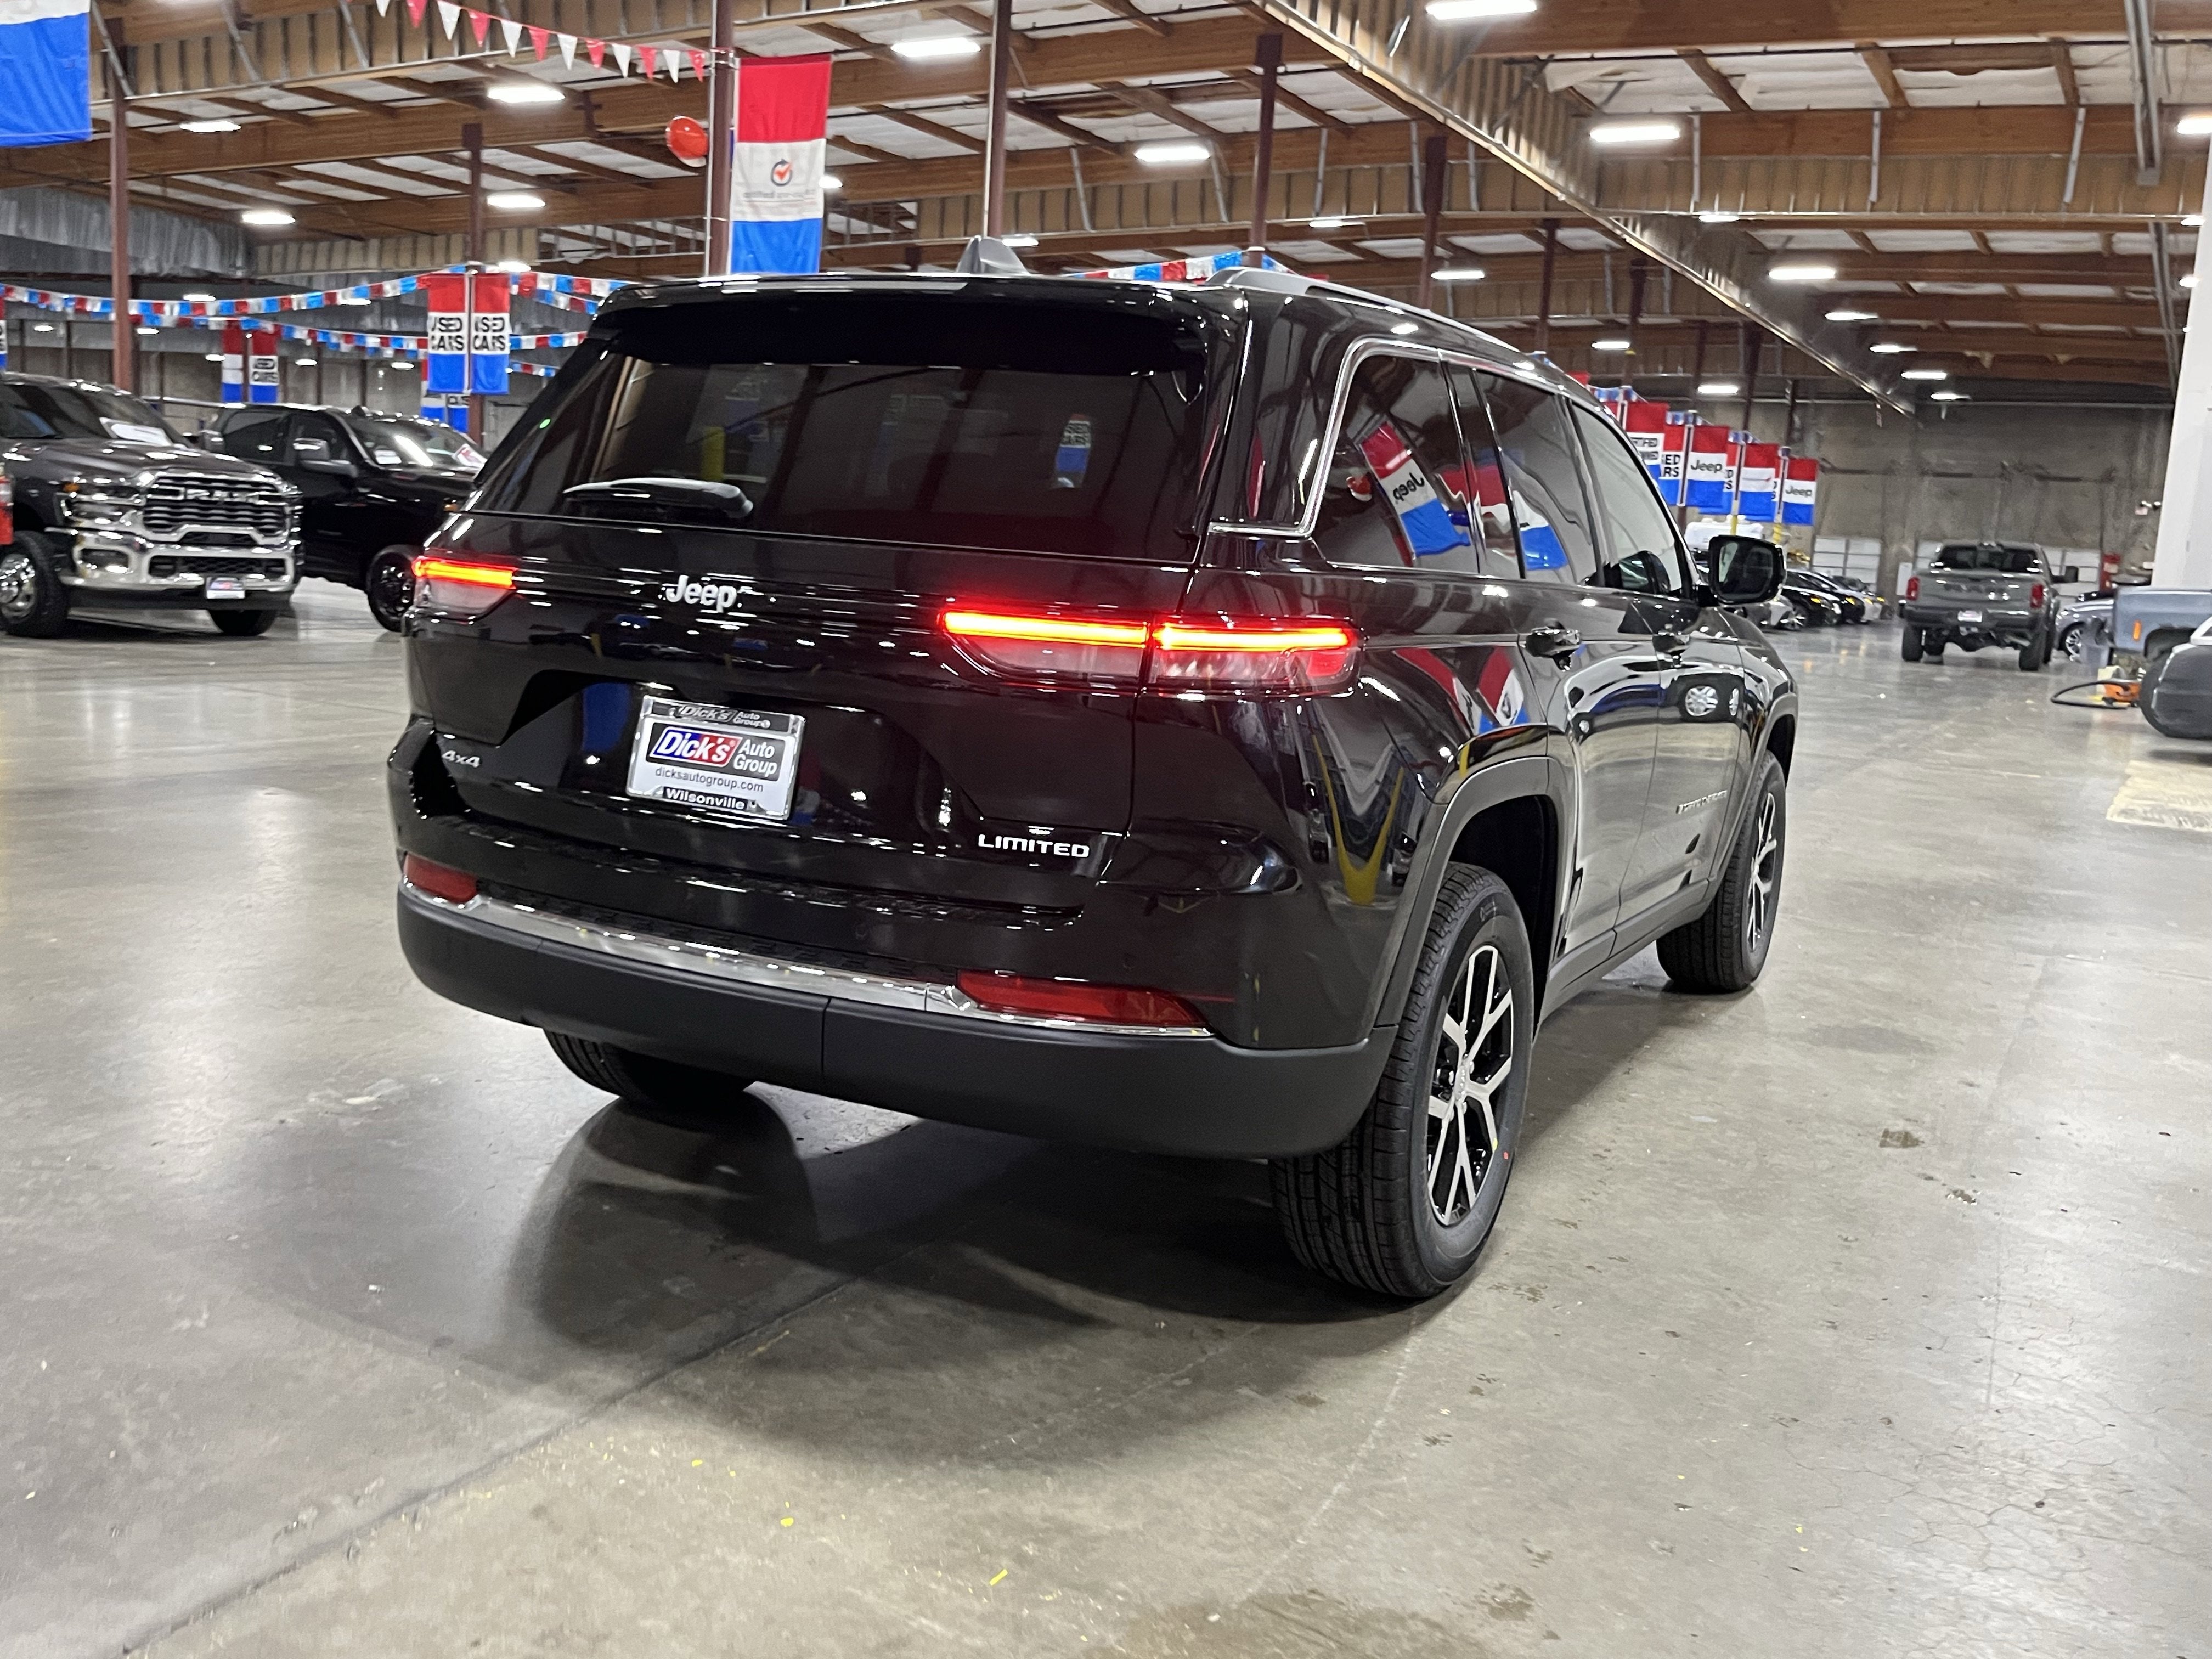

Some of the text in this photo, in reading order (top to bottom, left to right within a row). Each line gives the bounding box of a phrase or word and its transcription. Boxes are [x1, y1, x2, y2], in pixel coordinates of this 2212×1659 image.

[1662, 454, 1681, 465] ED
[1690, 459, 1723, 474] Jeep
[1663, 467, 1680, 477] RS
[665, 575, 737, 613] Jeep
[739, 712, 760, 720] Auto
[738, 739, 775, 758] Auto
[733, 754, 778, 777] Group
[655, 767, 764, 792] dicksautogroup.com
[665, 788, 745, 810] Wilsonville
[978, 834, 1090, 857] LIMITED
